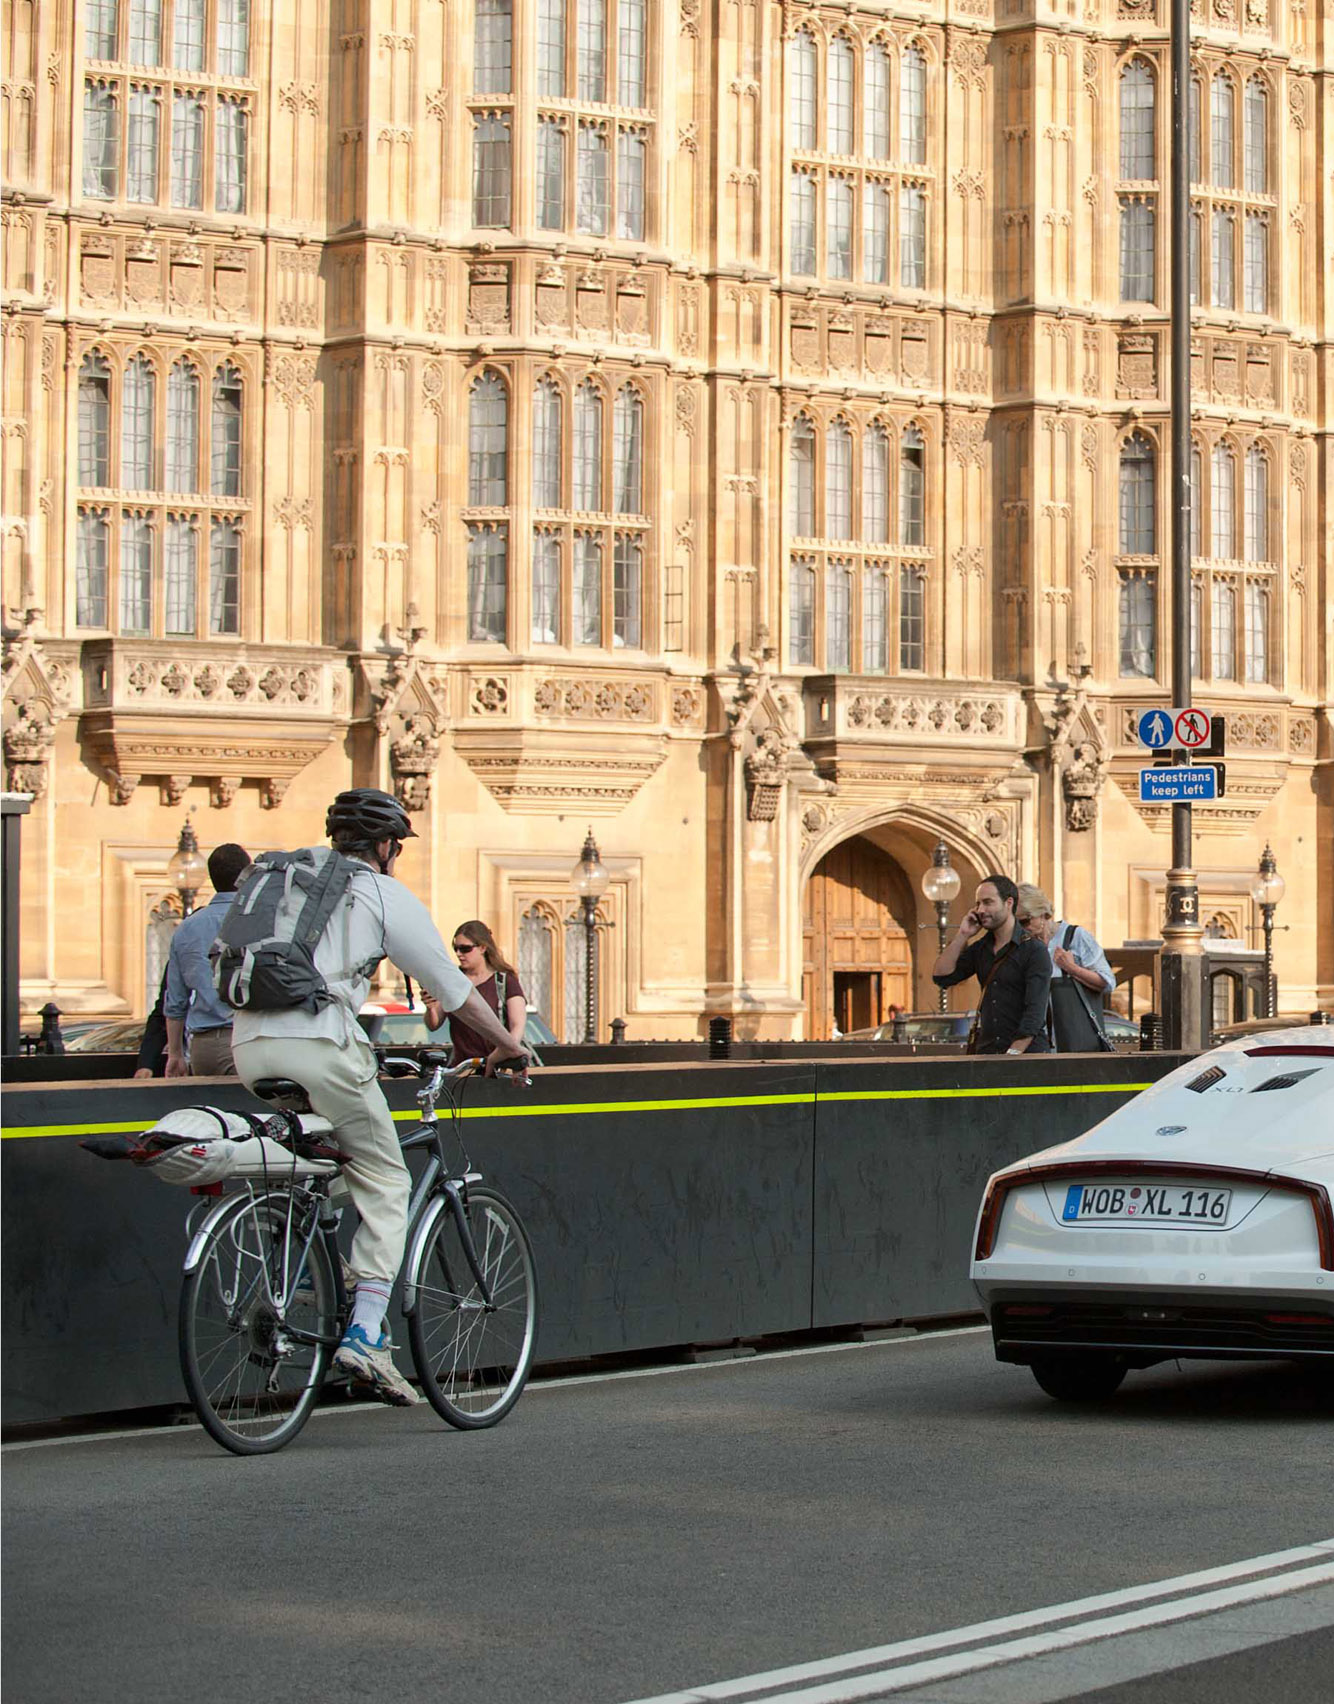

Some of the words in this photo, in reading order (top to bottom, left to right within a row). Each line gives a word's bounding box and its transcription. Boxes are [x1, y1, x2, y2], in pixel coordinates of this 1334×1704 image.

[1144, 772, 1211, 784] Pedestrians
[1152, 786, 1179, 797] keep
[1183, 784, 1204, 795] left
[1068, 1206, 1075, 1214] D
[1081, 1188, 1126, 1214] WOB
[1141, 1189, 1172, 1216] XL
[1178, 1190, 1225, 1218] 116
